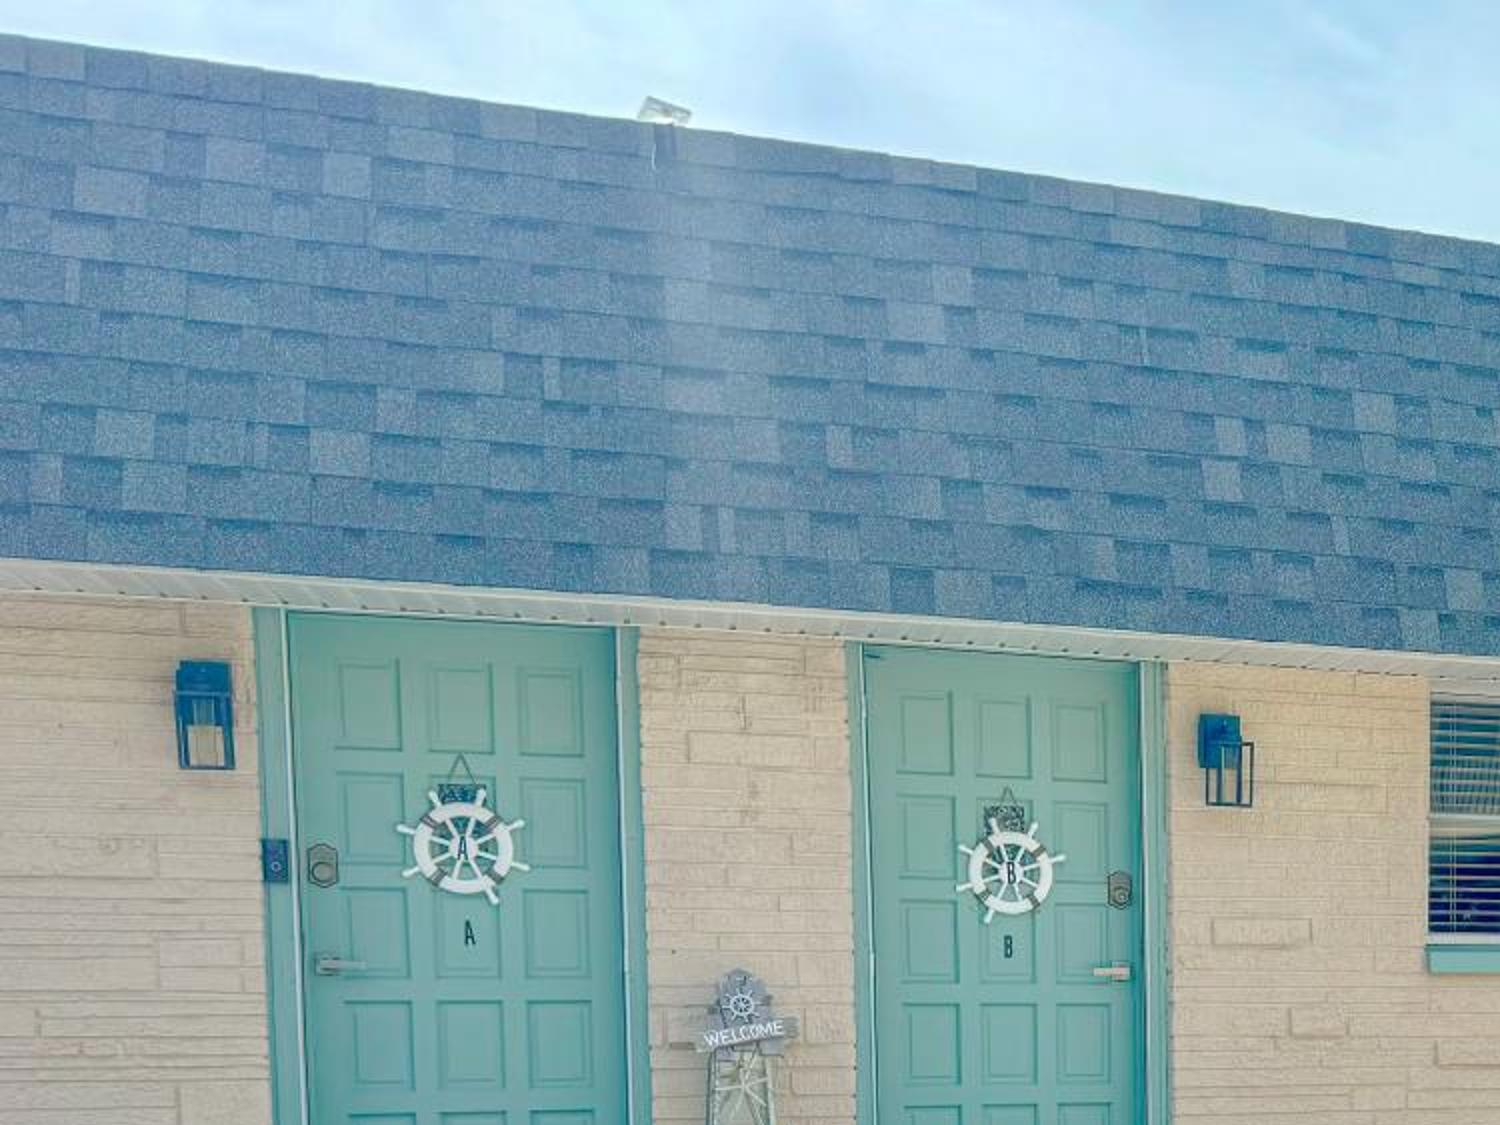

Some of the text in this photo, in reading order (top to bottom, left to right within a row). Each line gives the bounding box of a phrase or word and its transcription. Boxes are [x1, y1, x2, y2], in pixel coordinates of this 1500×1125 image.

[457, 835, 469, 860] A
[1007, 861, 1017, 884] B
[464, 919, 476, 945] A
[1004, 934, 1013, 958] B
[703, 1020, 784, 1046] WELCOME
